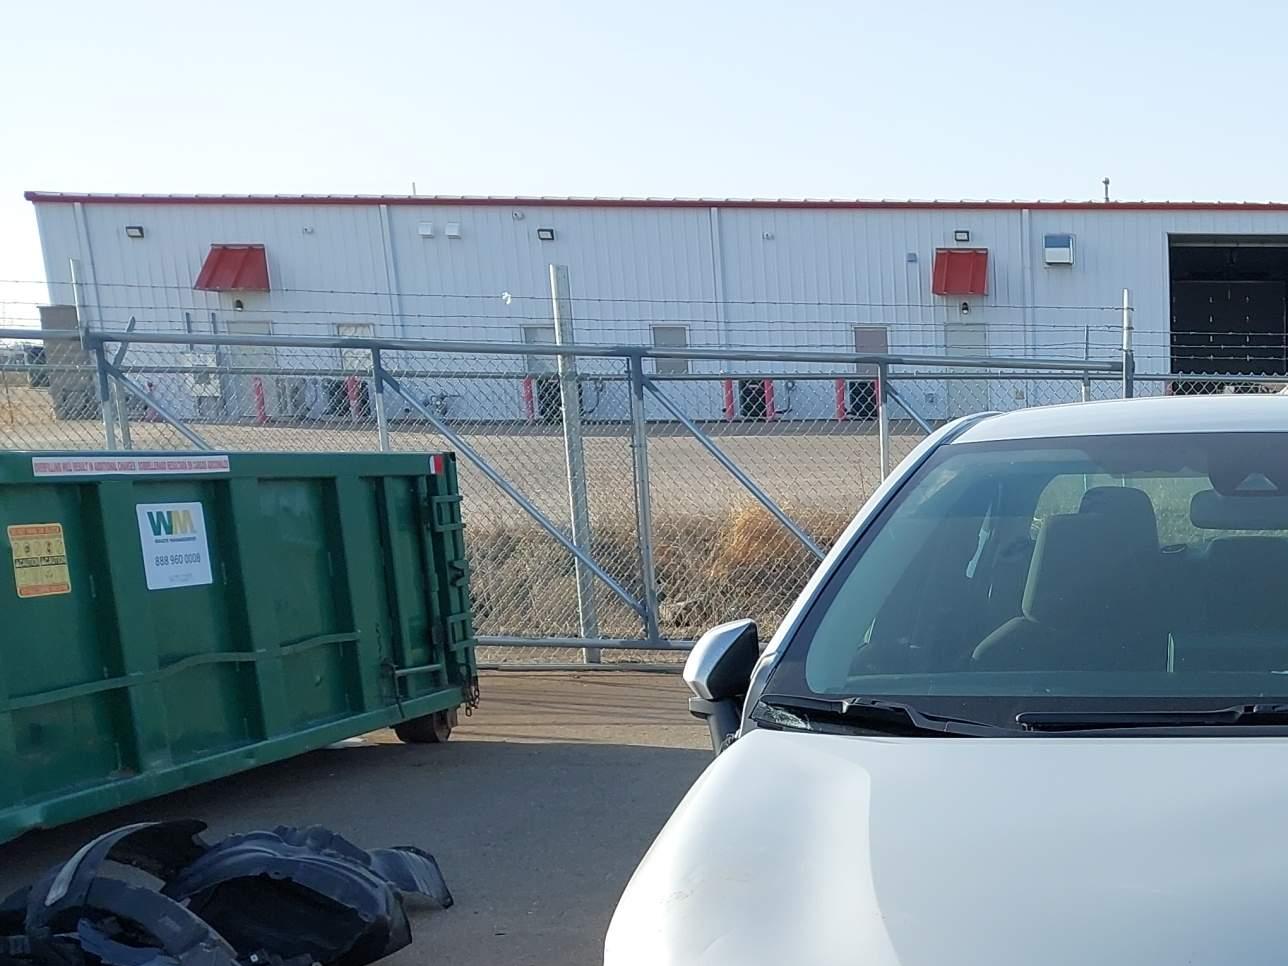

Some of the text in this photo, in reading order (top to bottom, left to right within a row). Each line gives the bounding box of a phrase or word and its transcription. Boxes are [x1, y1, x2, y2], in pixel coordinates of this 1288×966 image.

[147, 510, 193, 536] WM
[154, 555, 169, 567] 888
[170, 554, 183, 566] 960
